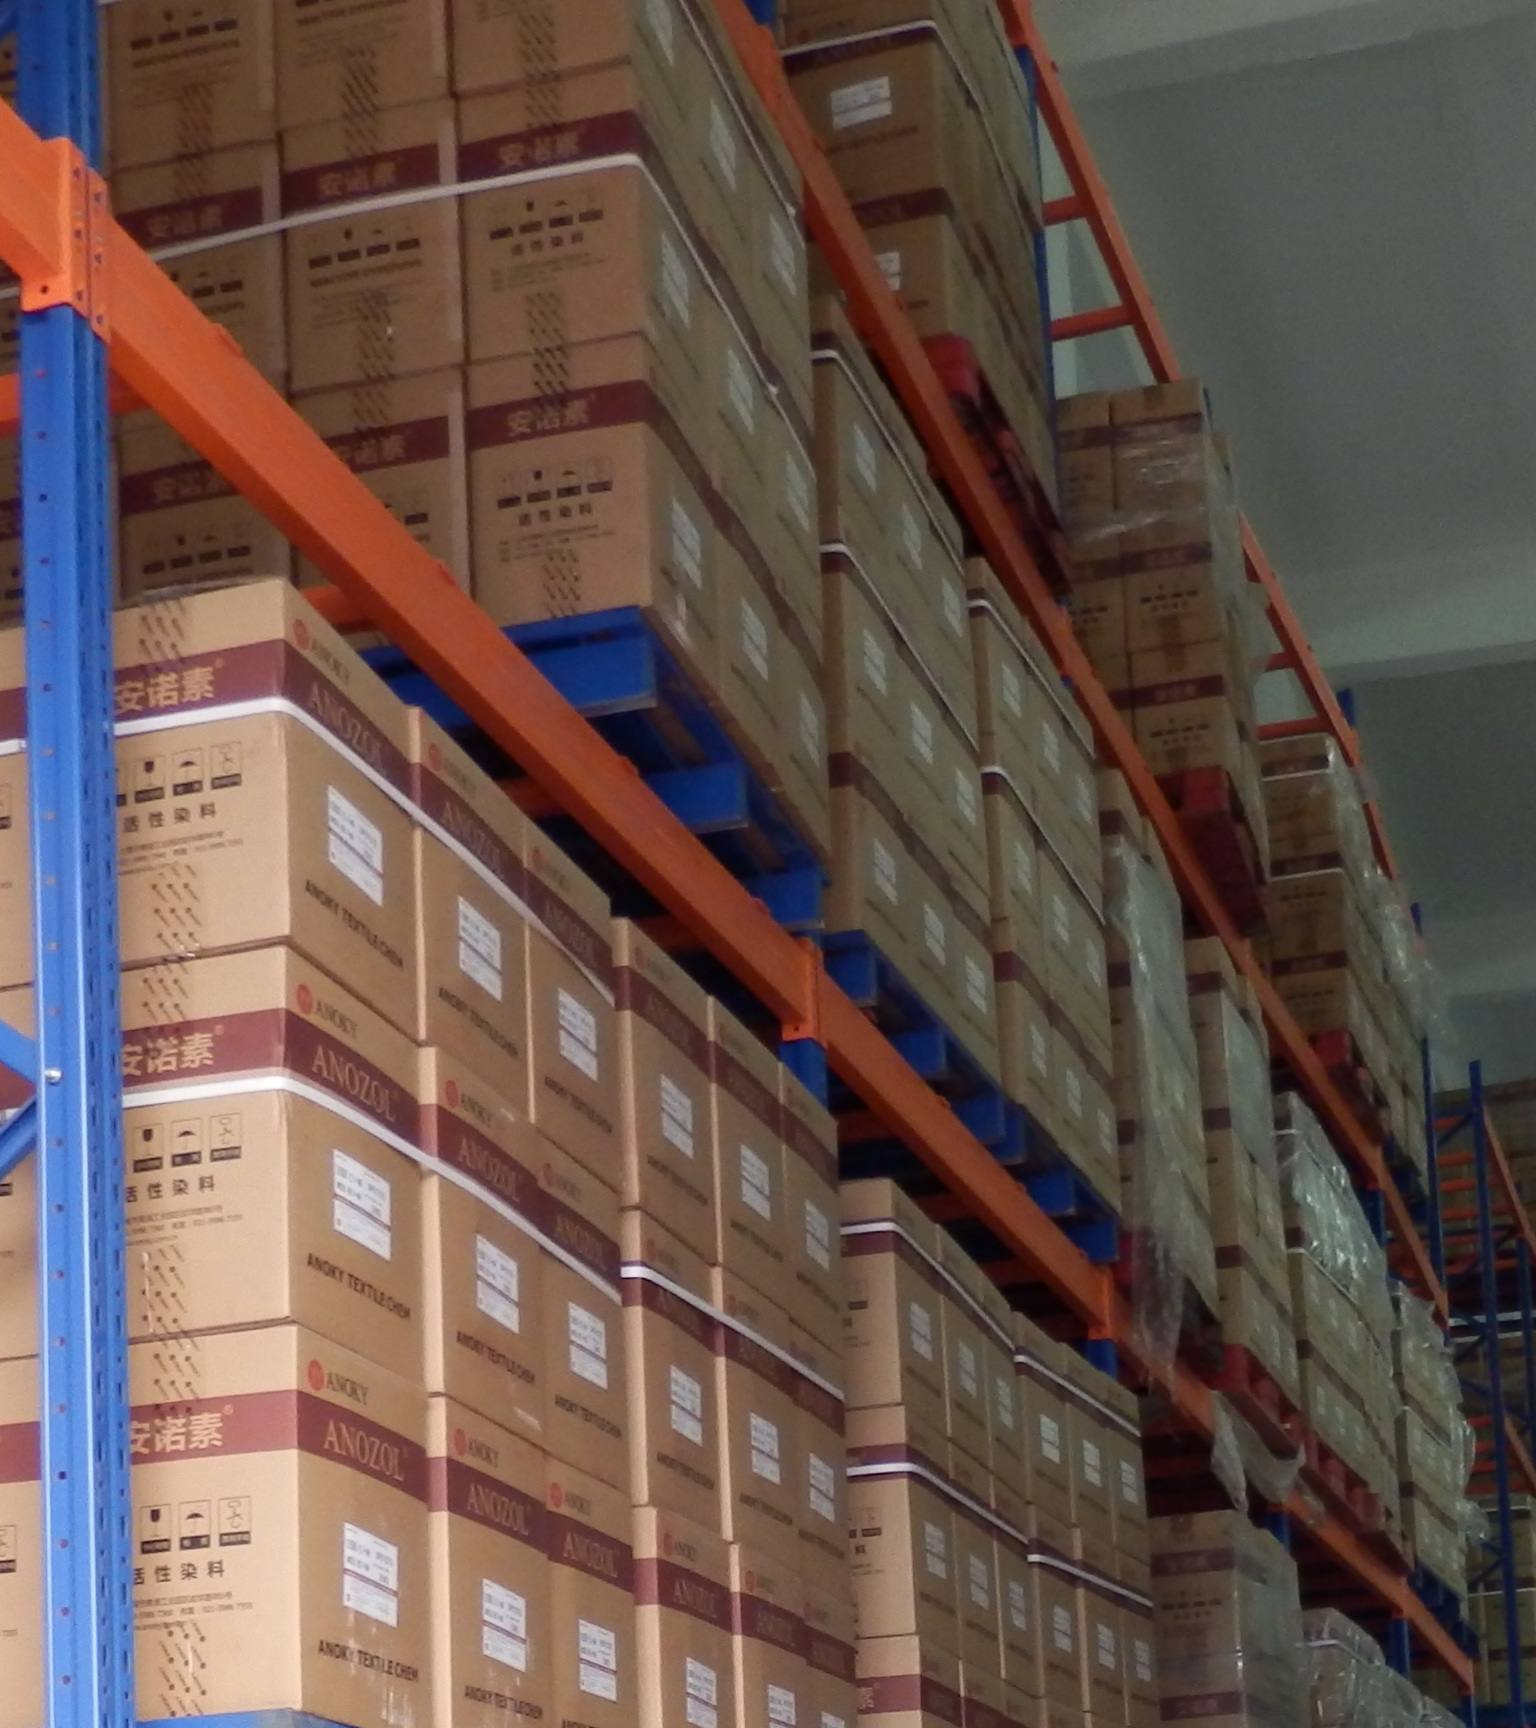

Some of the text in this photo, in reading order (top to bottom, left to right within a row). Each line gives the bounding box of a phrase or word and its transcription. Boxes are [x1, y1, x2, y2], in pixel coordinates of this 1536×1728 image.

[115, 664, 215, 715] 安诺素
[123, 802, 216, 834] 活性染料
[315, 1000, 359, 1040] ANOKY
[123, 1032, 215, 1076] 安诺素
[312, 1042, 398, 1124] ANOZOL
[307, 1253, 410, 1320] ANOKY TEXTILE CHEM
[325, 1371, 368, 1405] ANOKY
[130, 1411, 224, 1455] 安诺素
[325, 1422, 406, 1482] ANOZOL
[467, 1483, 530, 1536] ANOZOL
[135, 1560, 225, 1586] 活性染料
[564, 1533, 619, 1580] ANOZOL
[318, 1638, 419, 1683] ANOKY TEXTILE CHEM
